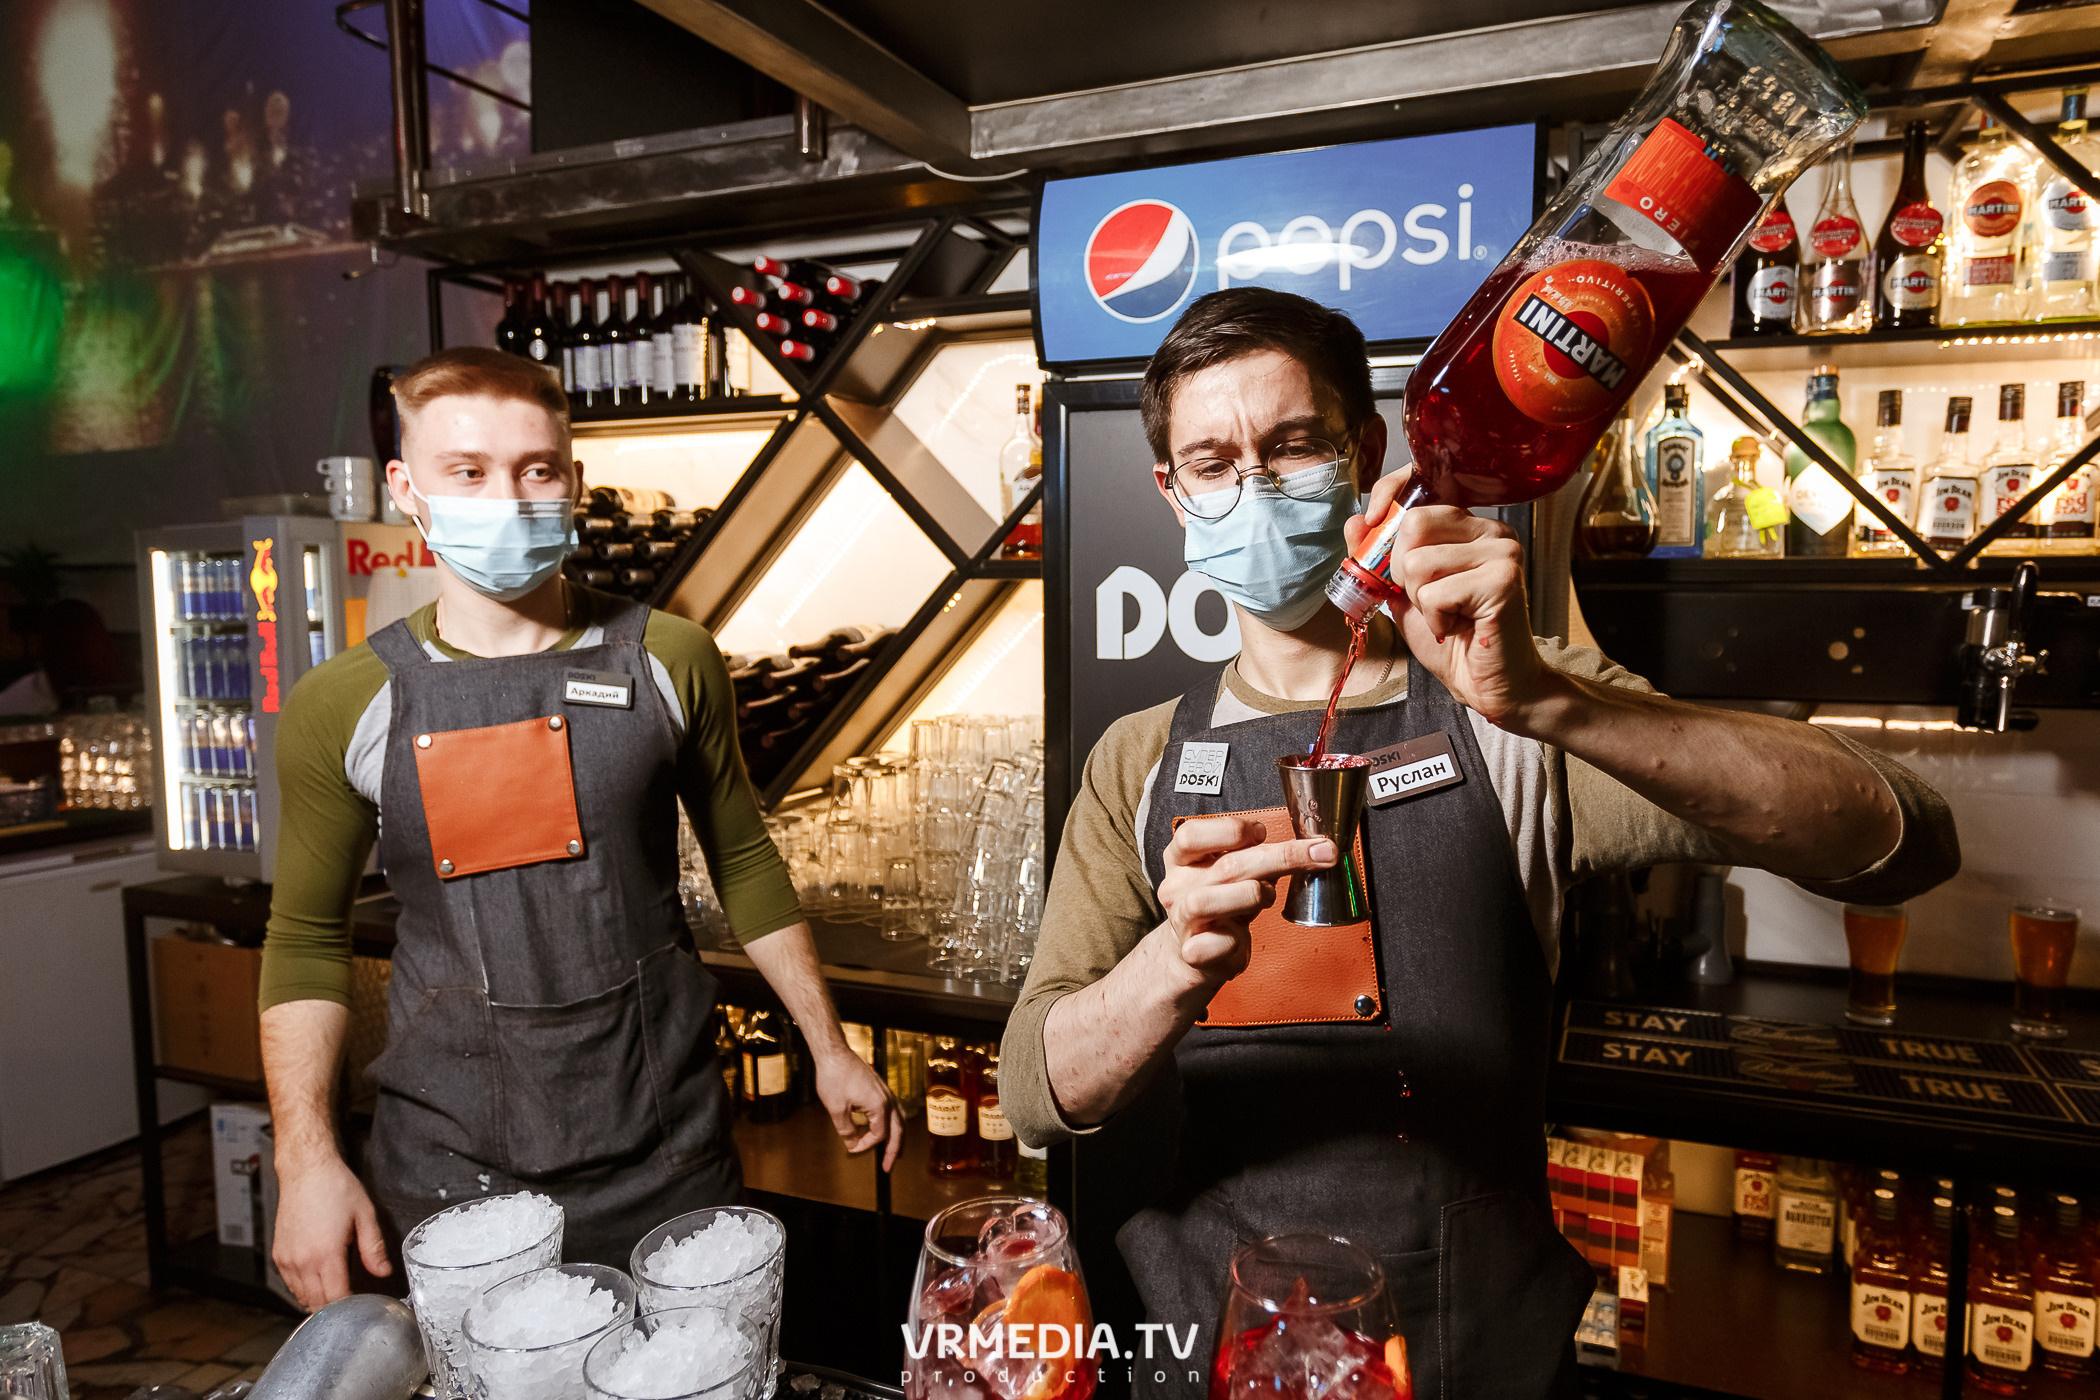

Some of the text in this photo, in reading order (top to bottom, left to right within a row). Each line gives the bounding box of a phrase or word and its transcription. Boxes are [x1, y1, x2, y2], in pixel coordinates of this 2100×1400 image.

[1216, 182, 1475, 291] pepsi
[1519, 298, 1628, 390] MARTINI
[570, 687, 620, 699] Аркадий
[1179, 773, 1220, 788] DOSKI
[1376, 761, 1447, 793] Руслан
[1603, 1009, 1689, 1034] STAY
[1879, 1037, 1982, 1064] TRUE
[1602, 1042, 1693, 1068] STAY
[1899, 1074, 2013, 1104] TRUE
